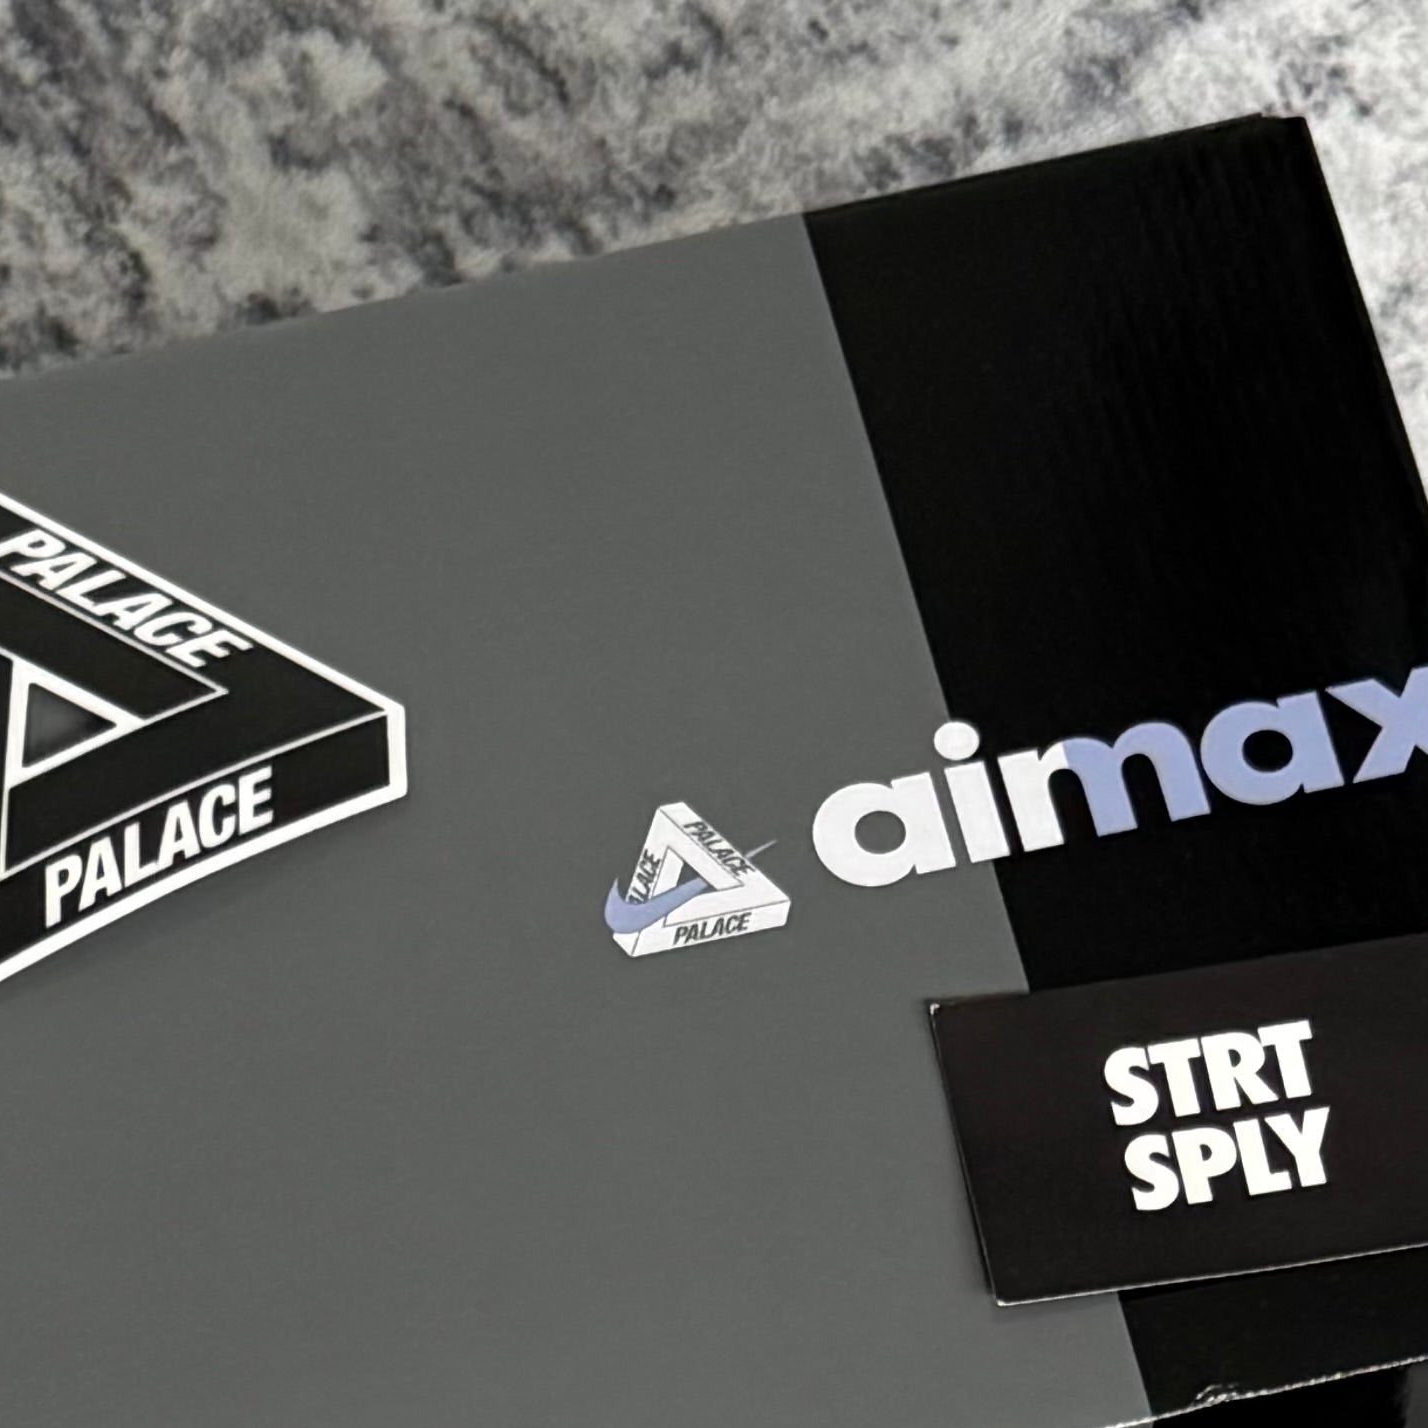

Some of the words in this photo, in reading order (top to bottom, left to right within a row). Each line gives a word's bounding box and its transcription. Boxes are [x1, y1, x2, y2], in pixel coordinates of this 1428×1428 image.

[44, 766, 273, 929] PALACE
[684, 821, 756, 877] PALACE
[673, 912, 752, 945] PALACE
[1103, 1020, 1313, 1126] STRT
[1124, 1107, 1331, 1211] SPLY
